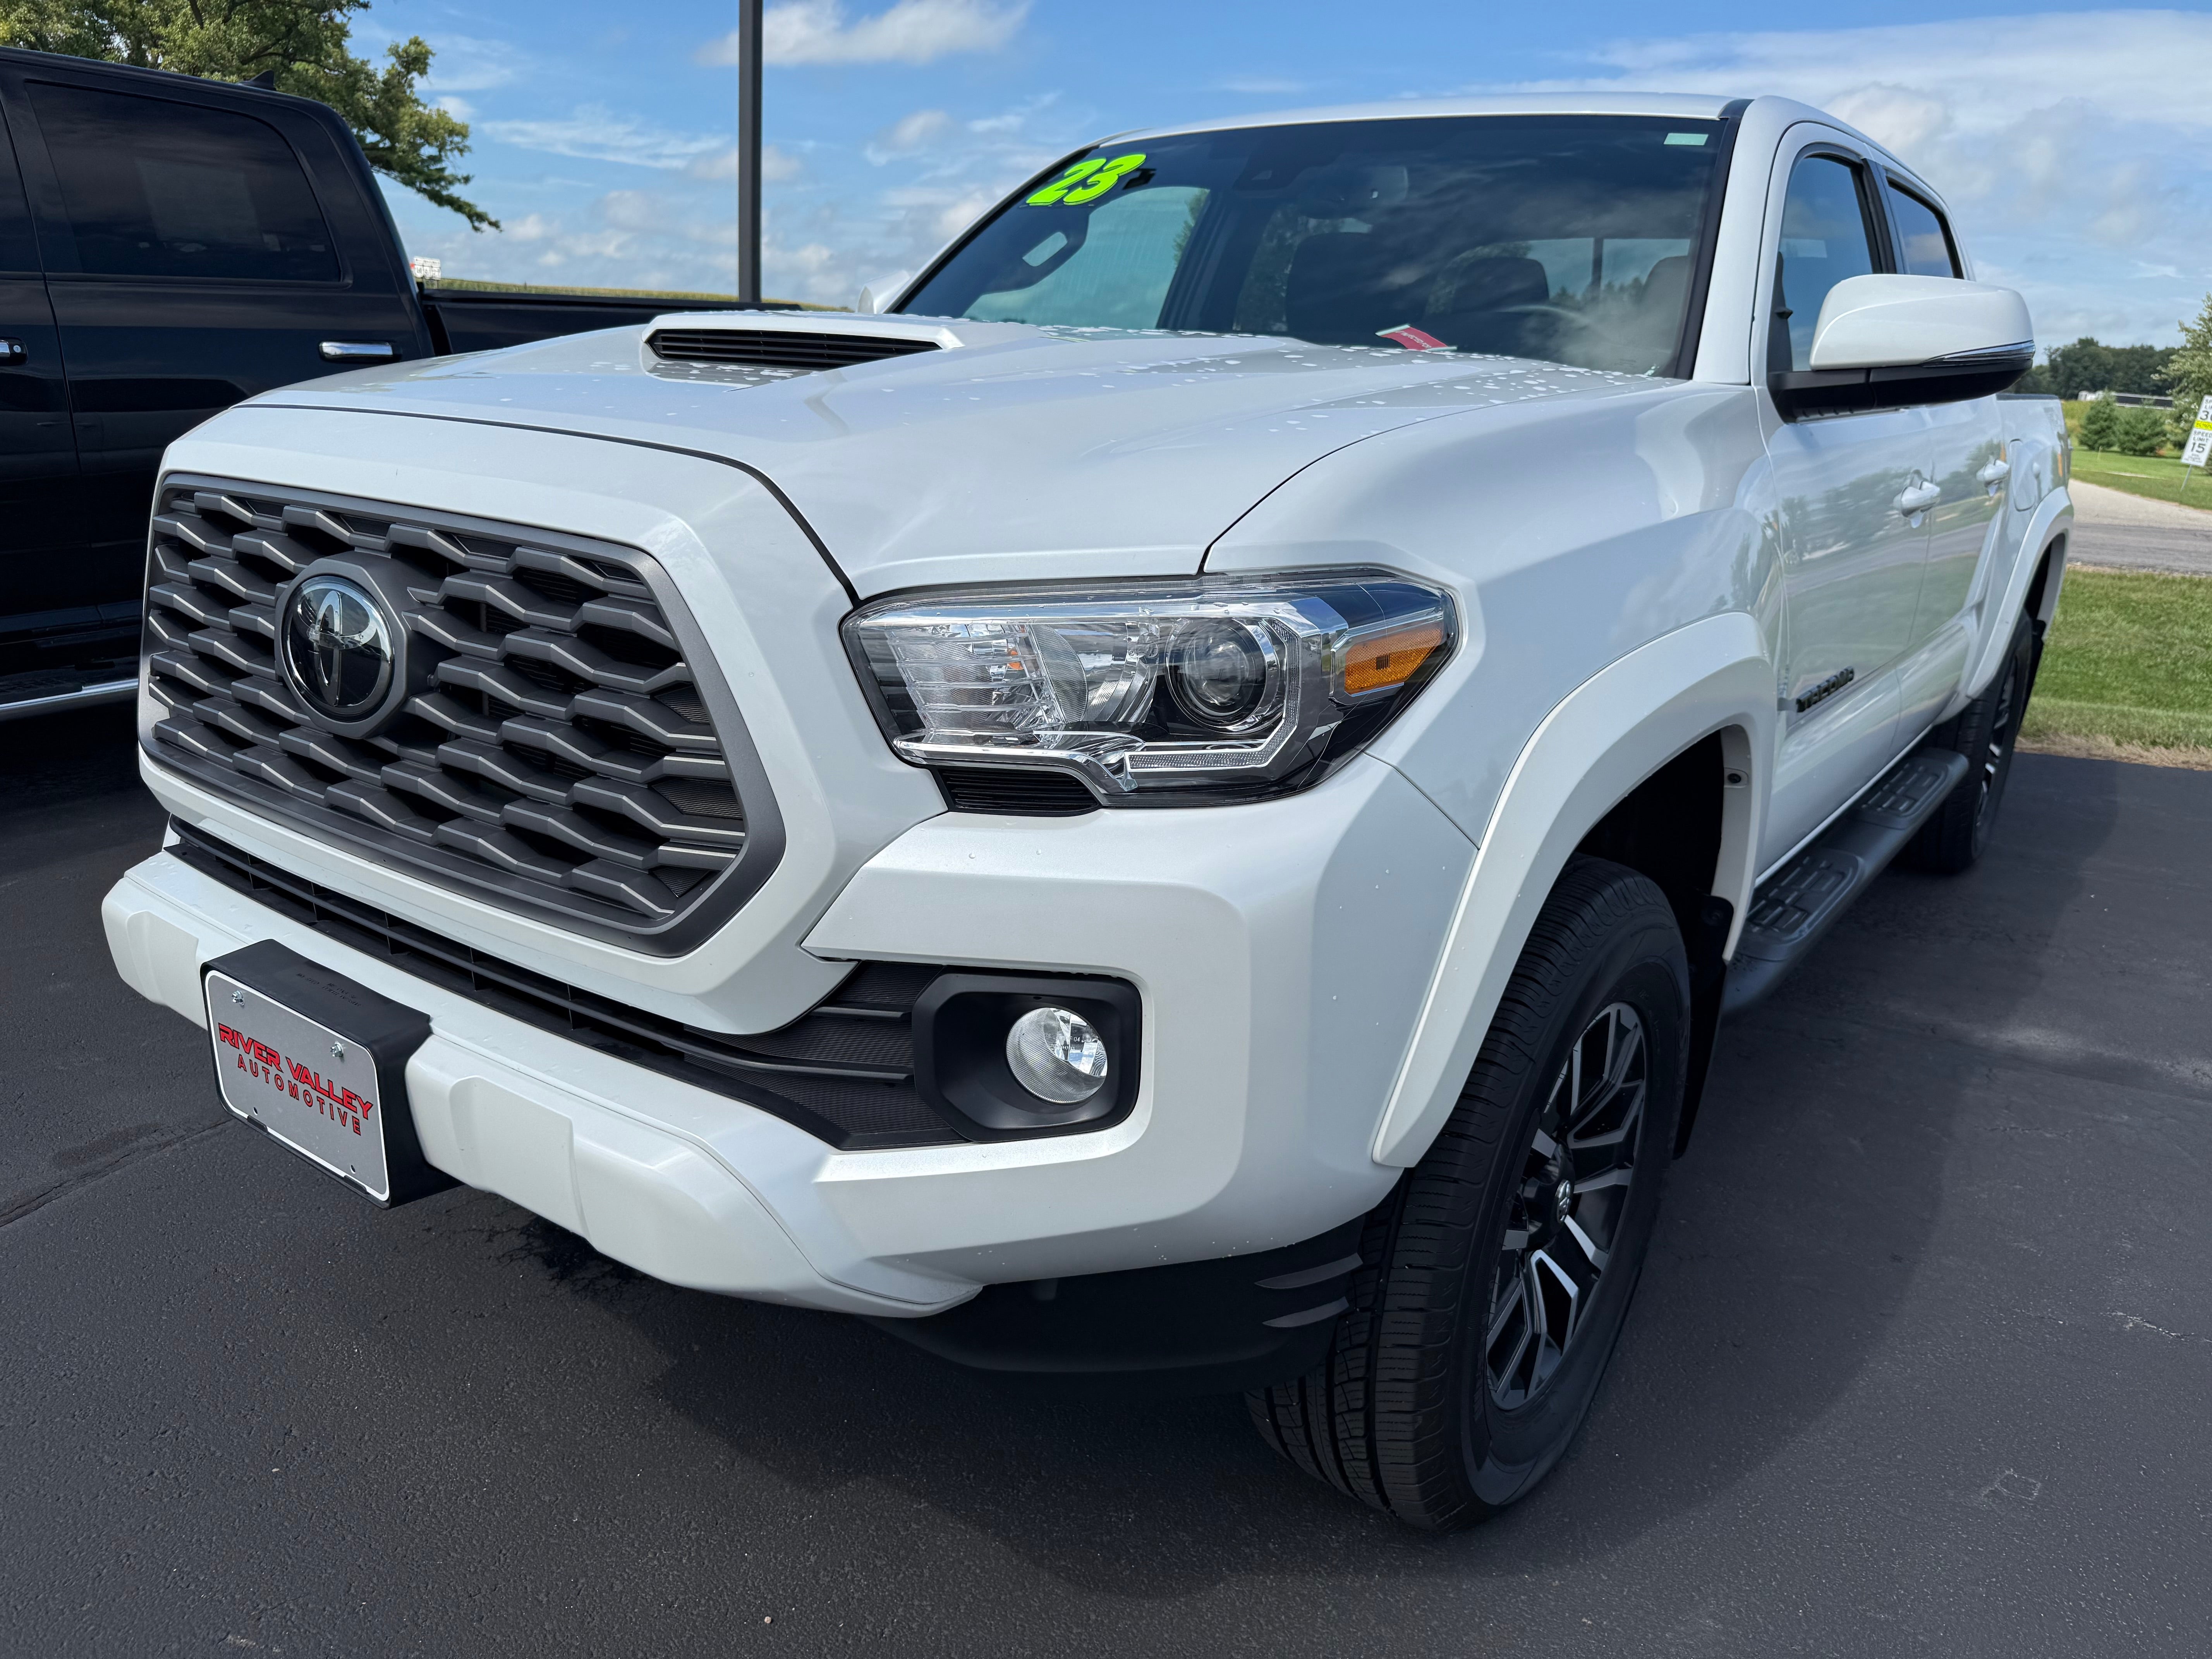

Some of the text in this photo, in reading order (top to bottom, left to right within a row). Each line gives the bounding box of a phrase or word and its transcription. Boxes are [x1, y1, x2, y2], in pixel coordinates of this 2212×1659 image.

[1026, 154, 1146, 206] 23
[2191, 442, 2206, 453] 15
[218, 1022, 373, 1120] RIVER VALLEY
[237, 1054, 361, 1136] AUTOMOTIVE
